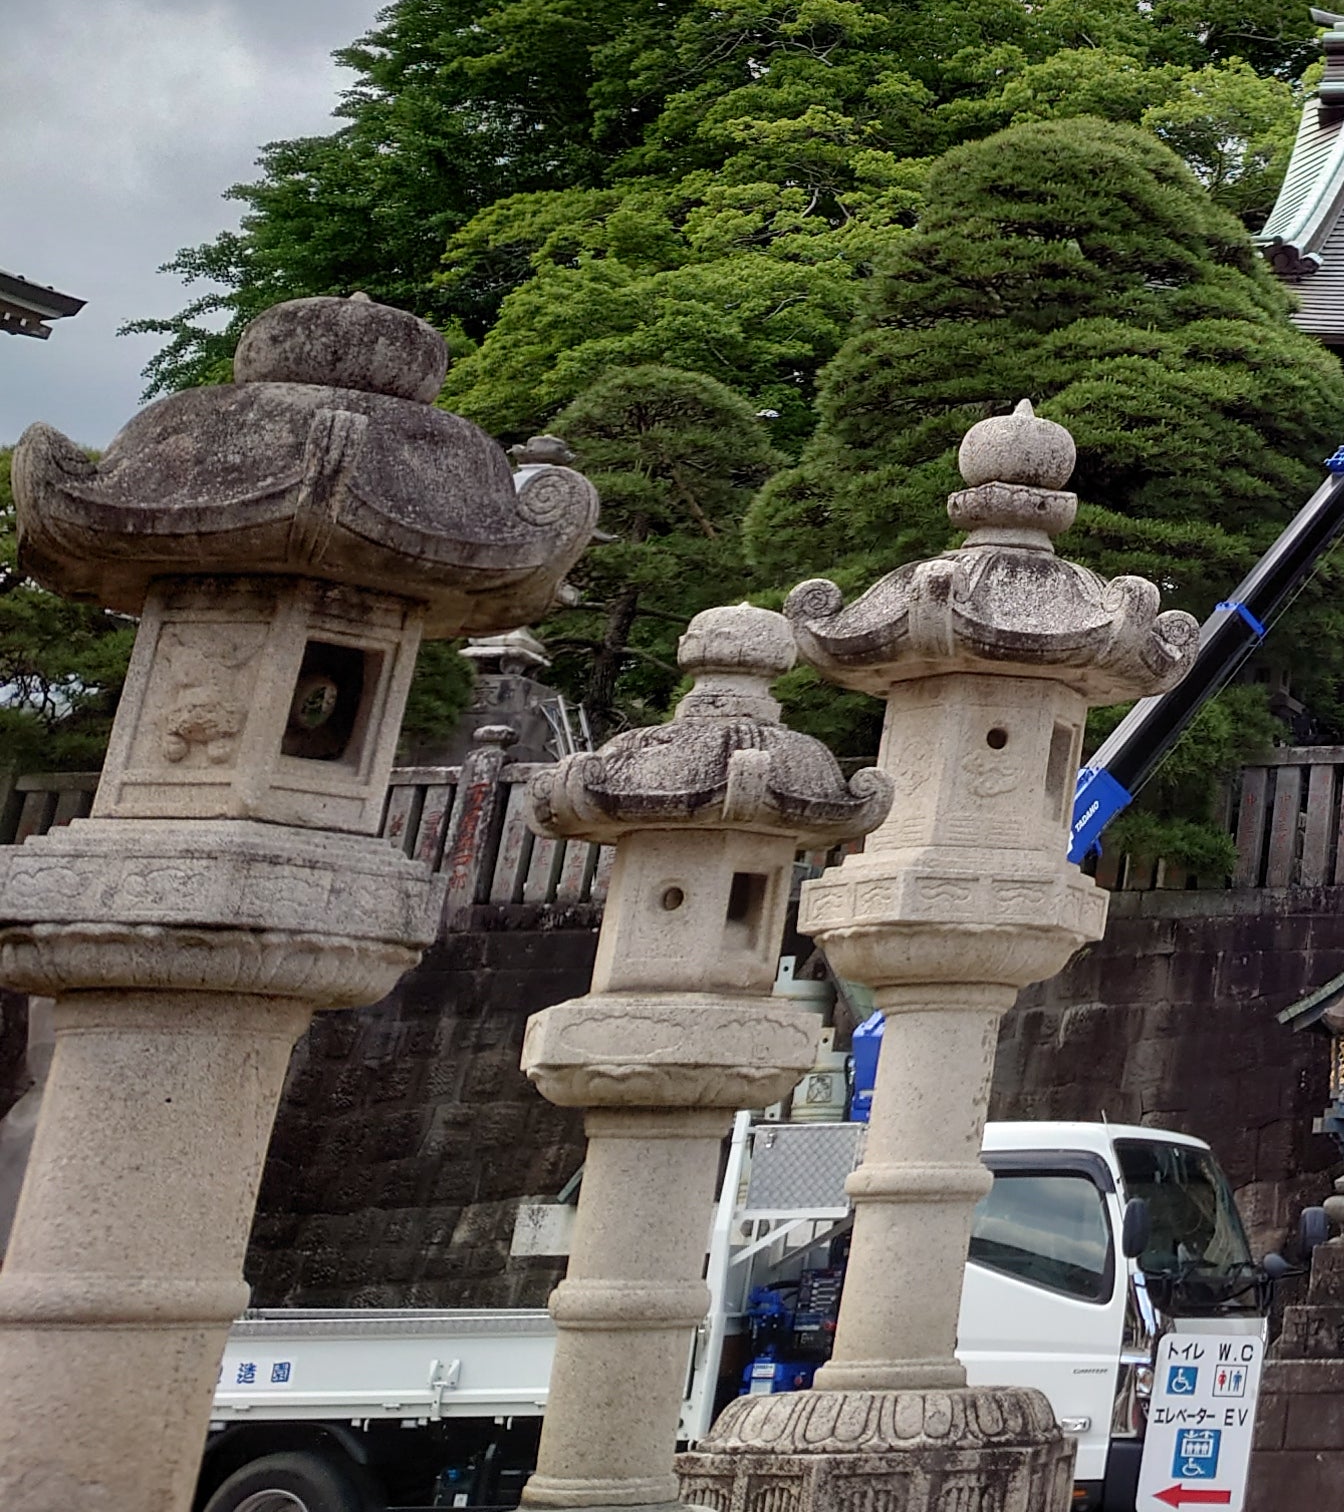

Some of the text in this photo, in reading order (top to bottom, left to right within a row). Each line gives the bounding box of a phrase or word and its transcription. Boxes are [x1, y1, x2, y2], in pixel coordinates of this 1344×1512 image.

[1168, 1342, 1254, 1362] トイレ W.C
[1154, 1407, 1248, 1426] エレベーター EV
